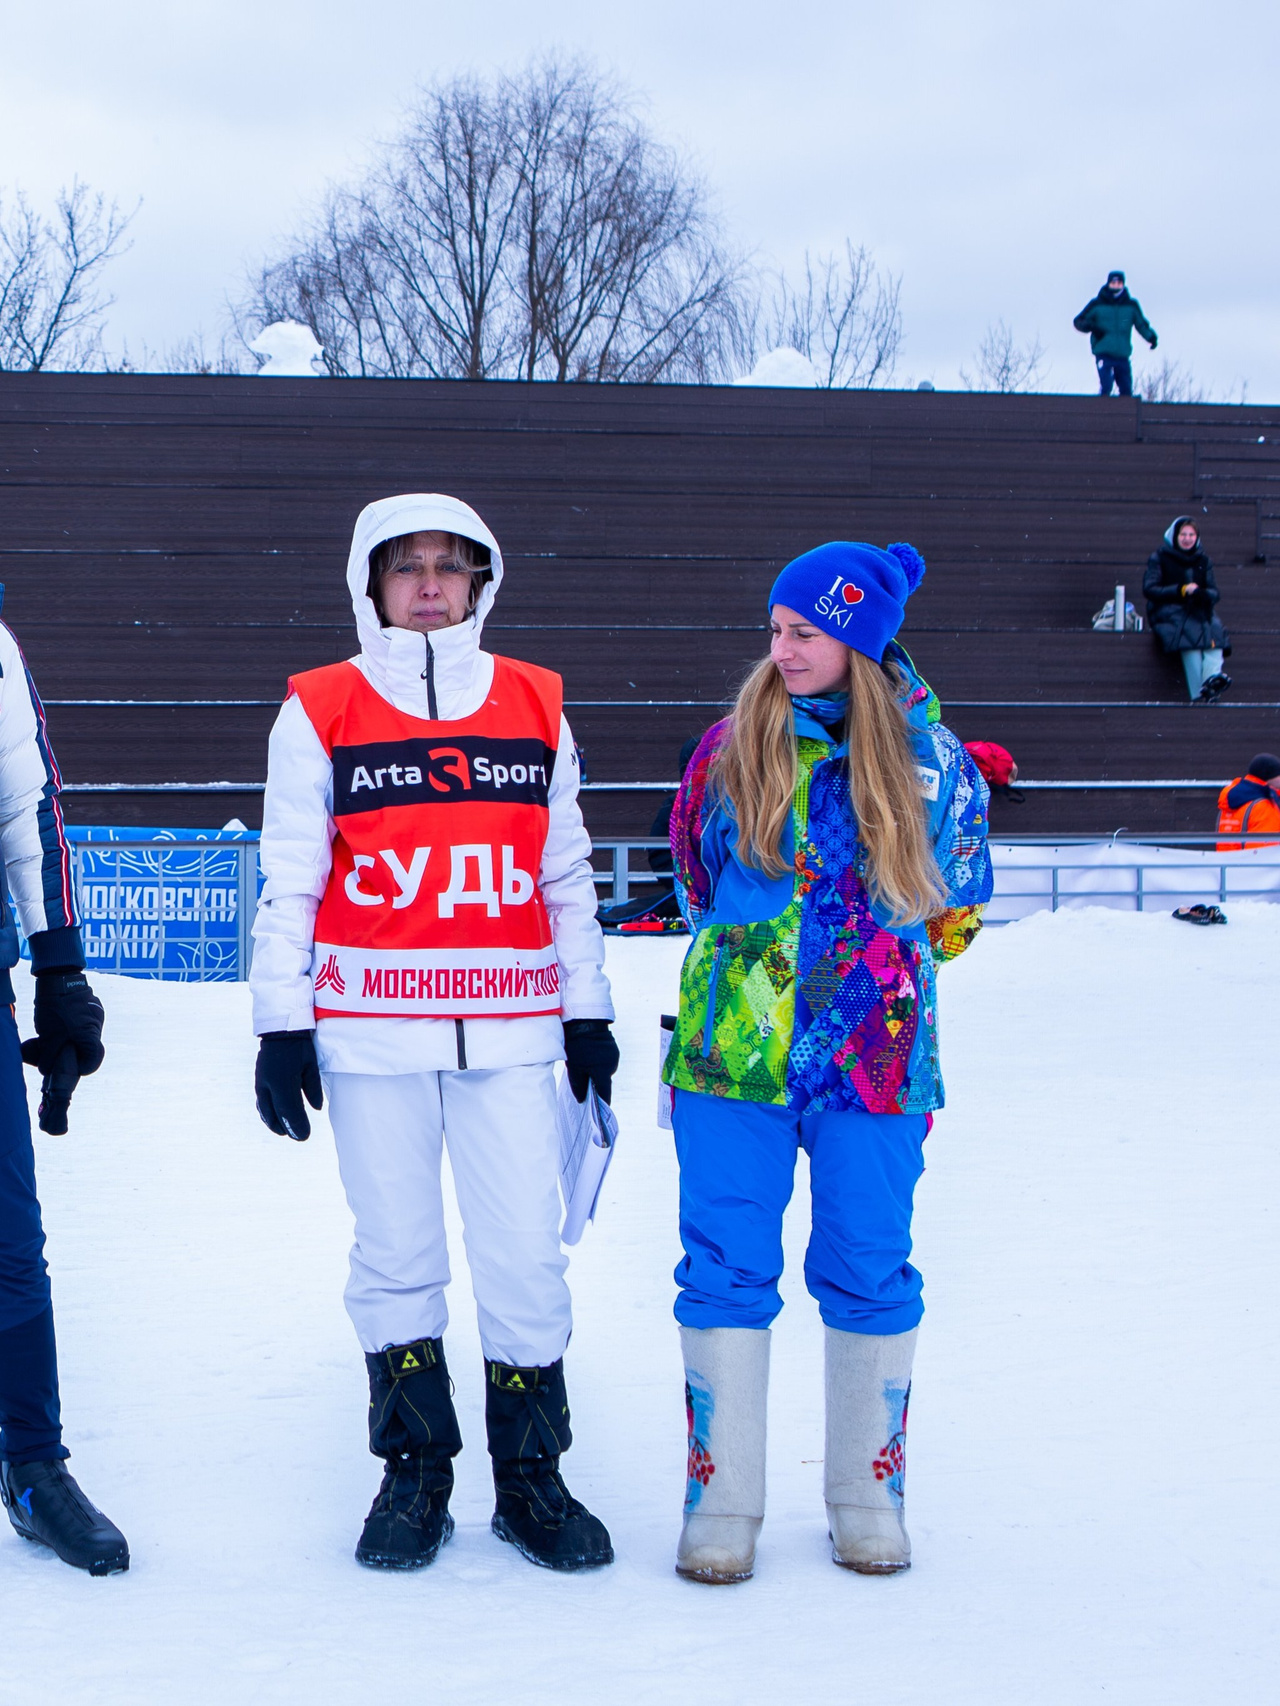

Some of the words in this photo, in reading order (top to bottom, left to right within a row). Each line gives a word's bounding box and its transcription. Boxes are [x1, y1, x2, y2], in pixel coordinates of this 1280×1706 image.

[827, 575, 845, 597] I
[814, 595, 853, 629] SKI
[350, 764, 422, 793] Arta
[473, 756, 547, 787] Sport
[343, 844, 539, 918] СУДЬ
[85, 924, 166, 959] ЫЖНЯ
[362, 961, 528, 999] МОСКОВСКИЙ
